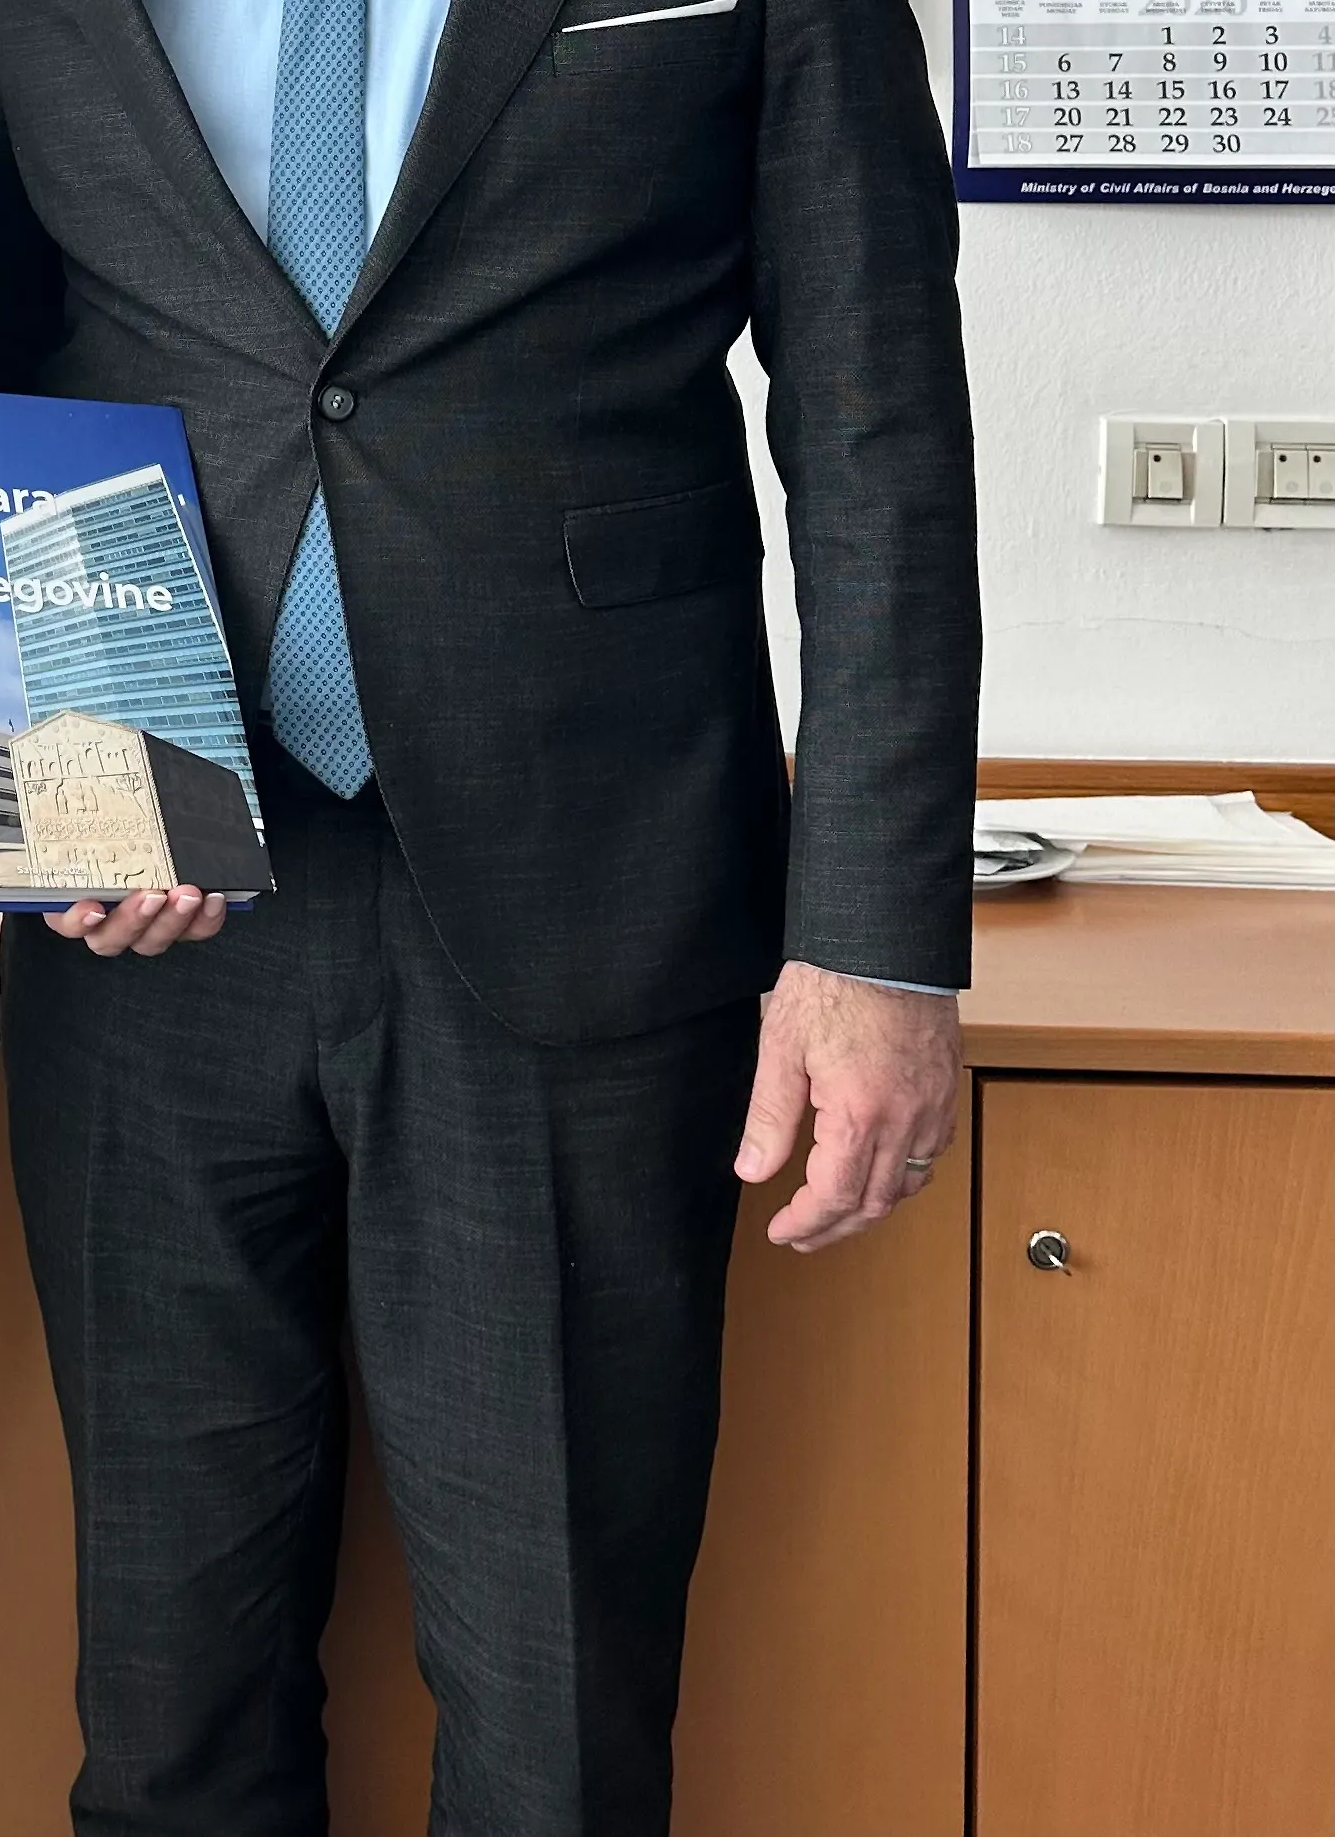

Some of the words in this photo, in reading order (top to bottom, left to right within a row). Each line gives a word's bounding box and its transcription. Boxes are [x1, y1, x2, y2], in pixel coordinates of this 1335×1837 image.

[998, 26, 1027, 46] 14
[1162, 27, 1174, 44] 1
[1213, 26, 1226, 44] 2
[1266, 26, 1278, 44] 3
[1319, 26, 1331, 44] 4
[999, 53, 1027, 72] 15
[1058, 53, 1071, 72] 6
[1109, 54, 1123, 71] 7
[1163, 53, 1176, 71] 8
[1214, 53, 1226, 71] 9
[1259, 53, 1287, 71] 10
[1000, 79, 1029, 99] 16
[1052, 81, 1080, 99] 13
[1104, 81, 1132, 99] 14
[1157, 81, 1184, 99] 15
[1208, 80, 1236, 99] 16
[1261, 81, 1289, 99] 17
[1002, 106, 1030, 126] 17
[1054, 108, 1081, 126] 20
[1107, 108, 1132, 126] 21
[1159, 108, 1187, 126] 22
[1211, 107, 1238, 126] 23
[1264, 108, 1291, 126] 24
[1004, 132, 1032, 153] 18
[1056, 135, 1083, 152] 27
[1109, 135, 1136, 152] 28
[1162, 135, 1188, 153] 29
[1213, 135, 1240, 153] 30
[1021, 183, 1077, 196] Ministry
[1080, 183, 1096, 194] of
[1100, 183, 1131, 194] Civil
[1133, 183, 1179, 194] Affairs
[1183, 183, 1199, 194] of
[1202, 183, 1249, 194] Bosnia
[1252, 183, 1279, 194] and
